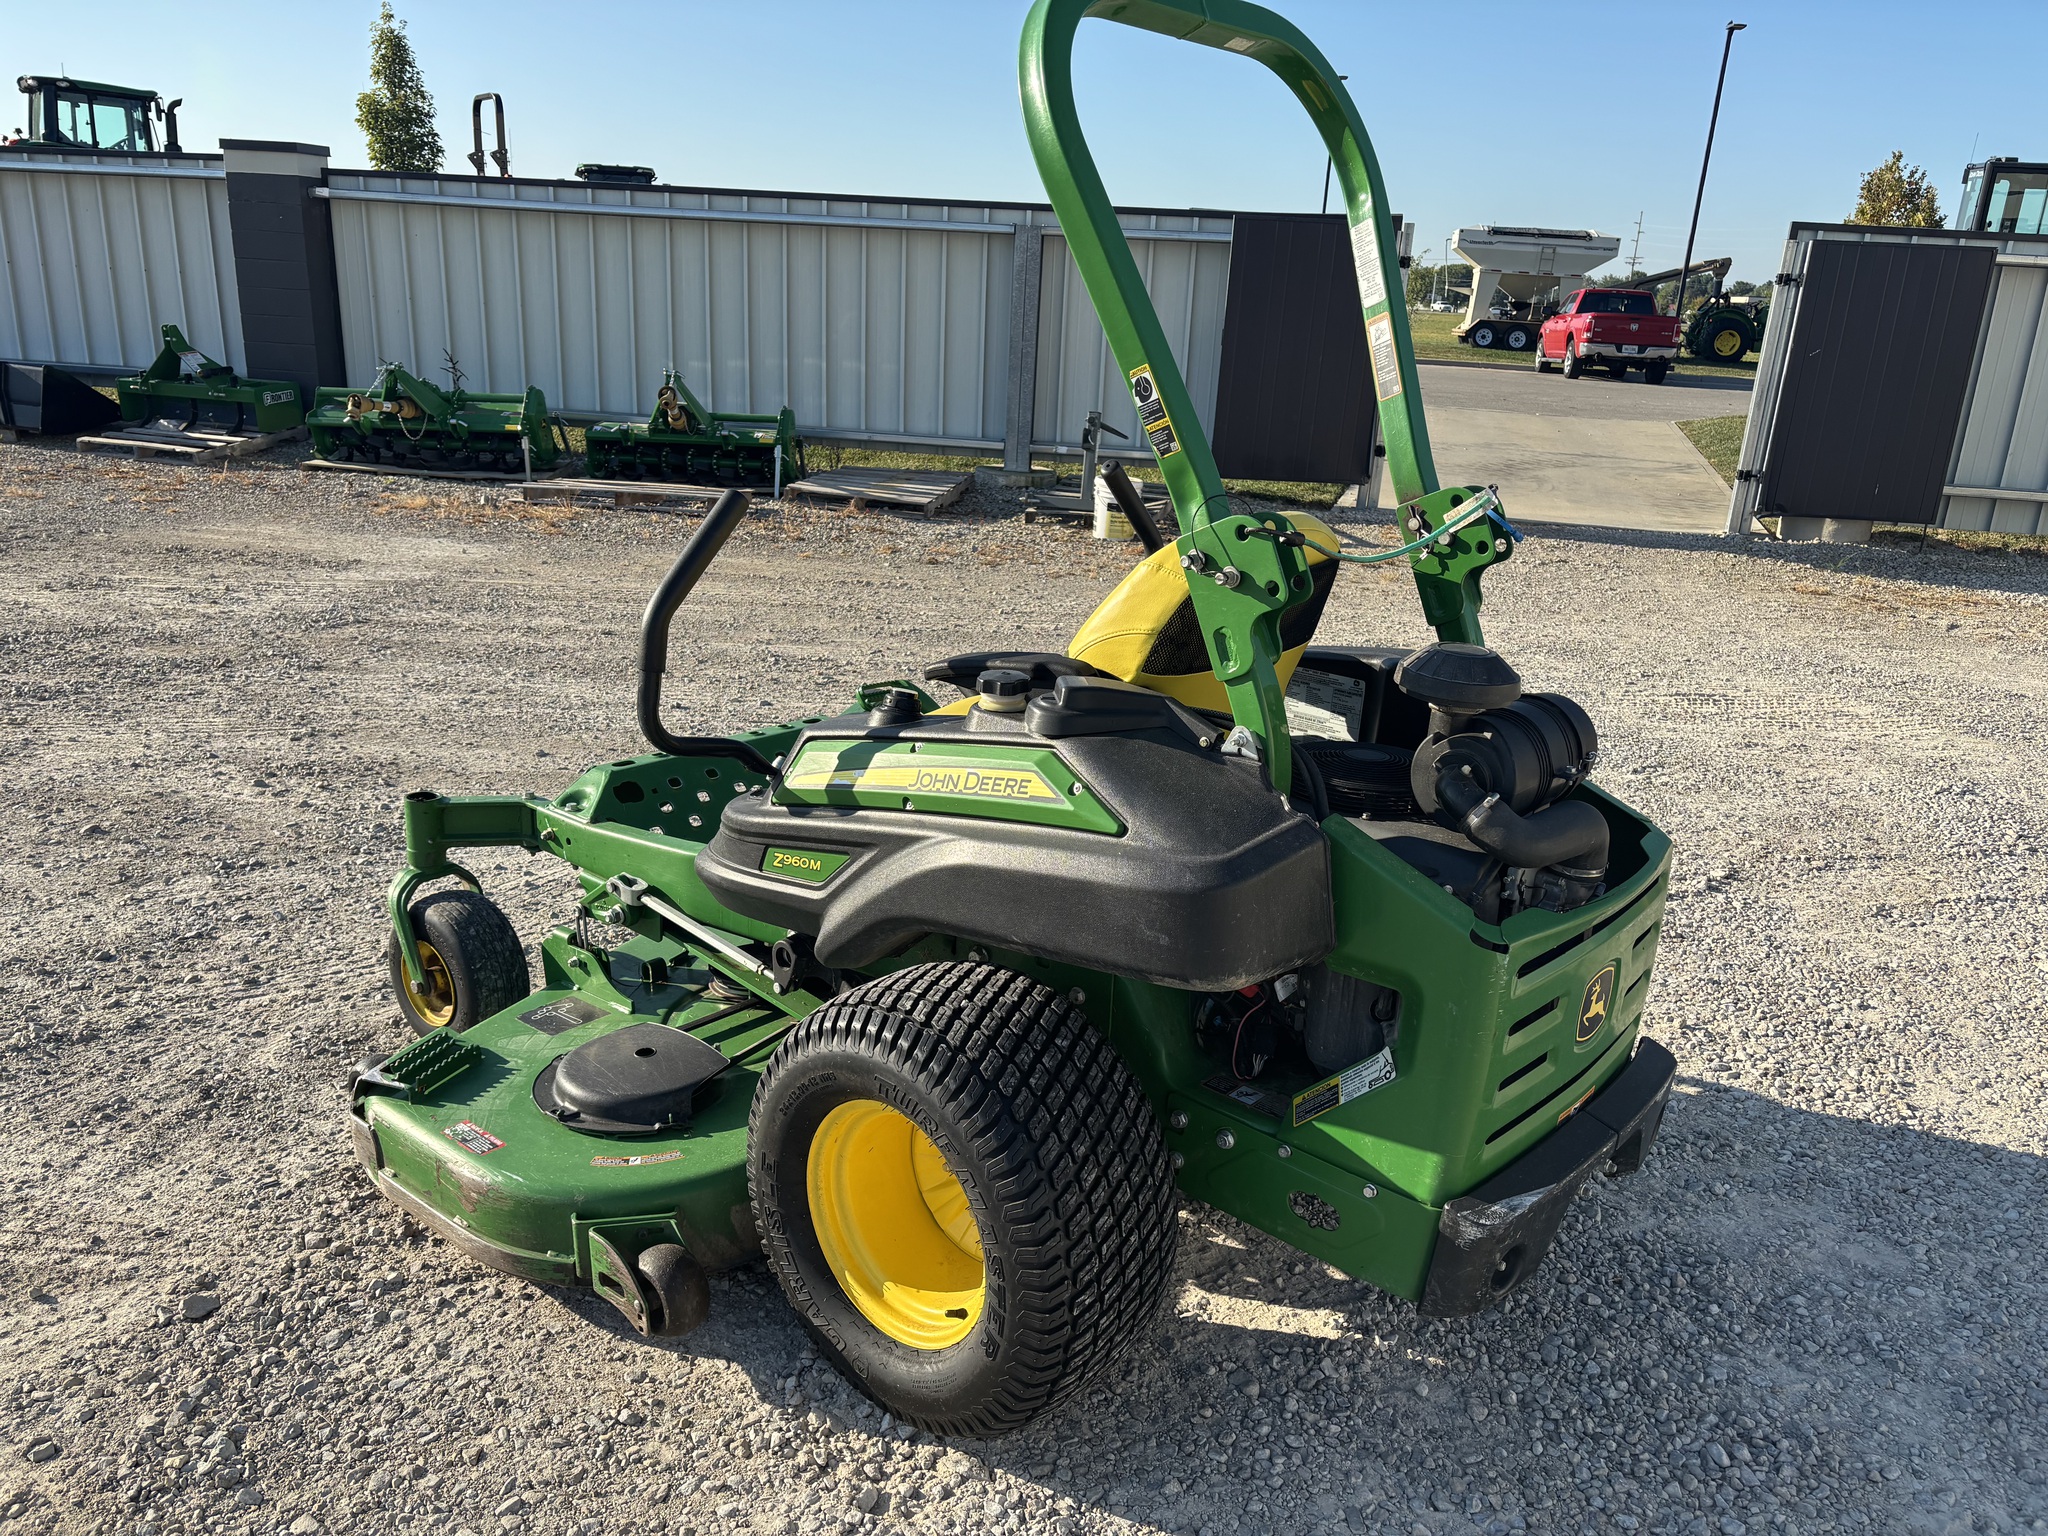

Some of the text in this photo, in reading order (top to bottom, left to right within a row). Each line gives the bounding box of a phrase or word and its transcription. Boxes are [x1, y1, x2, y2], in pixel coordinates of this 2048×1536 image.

[263, 390, 294, 404] FRONTIER
[908, 769, 1032, 795] JOHN DEERE
[772, 852, 822, 871] Z960M
[874, 1074, 1007, 1362] TURF MASTER
[761, 1151, 847, 1352] CARLISLE
